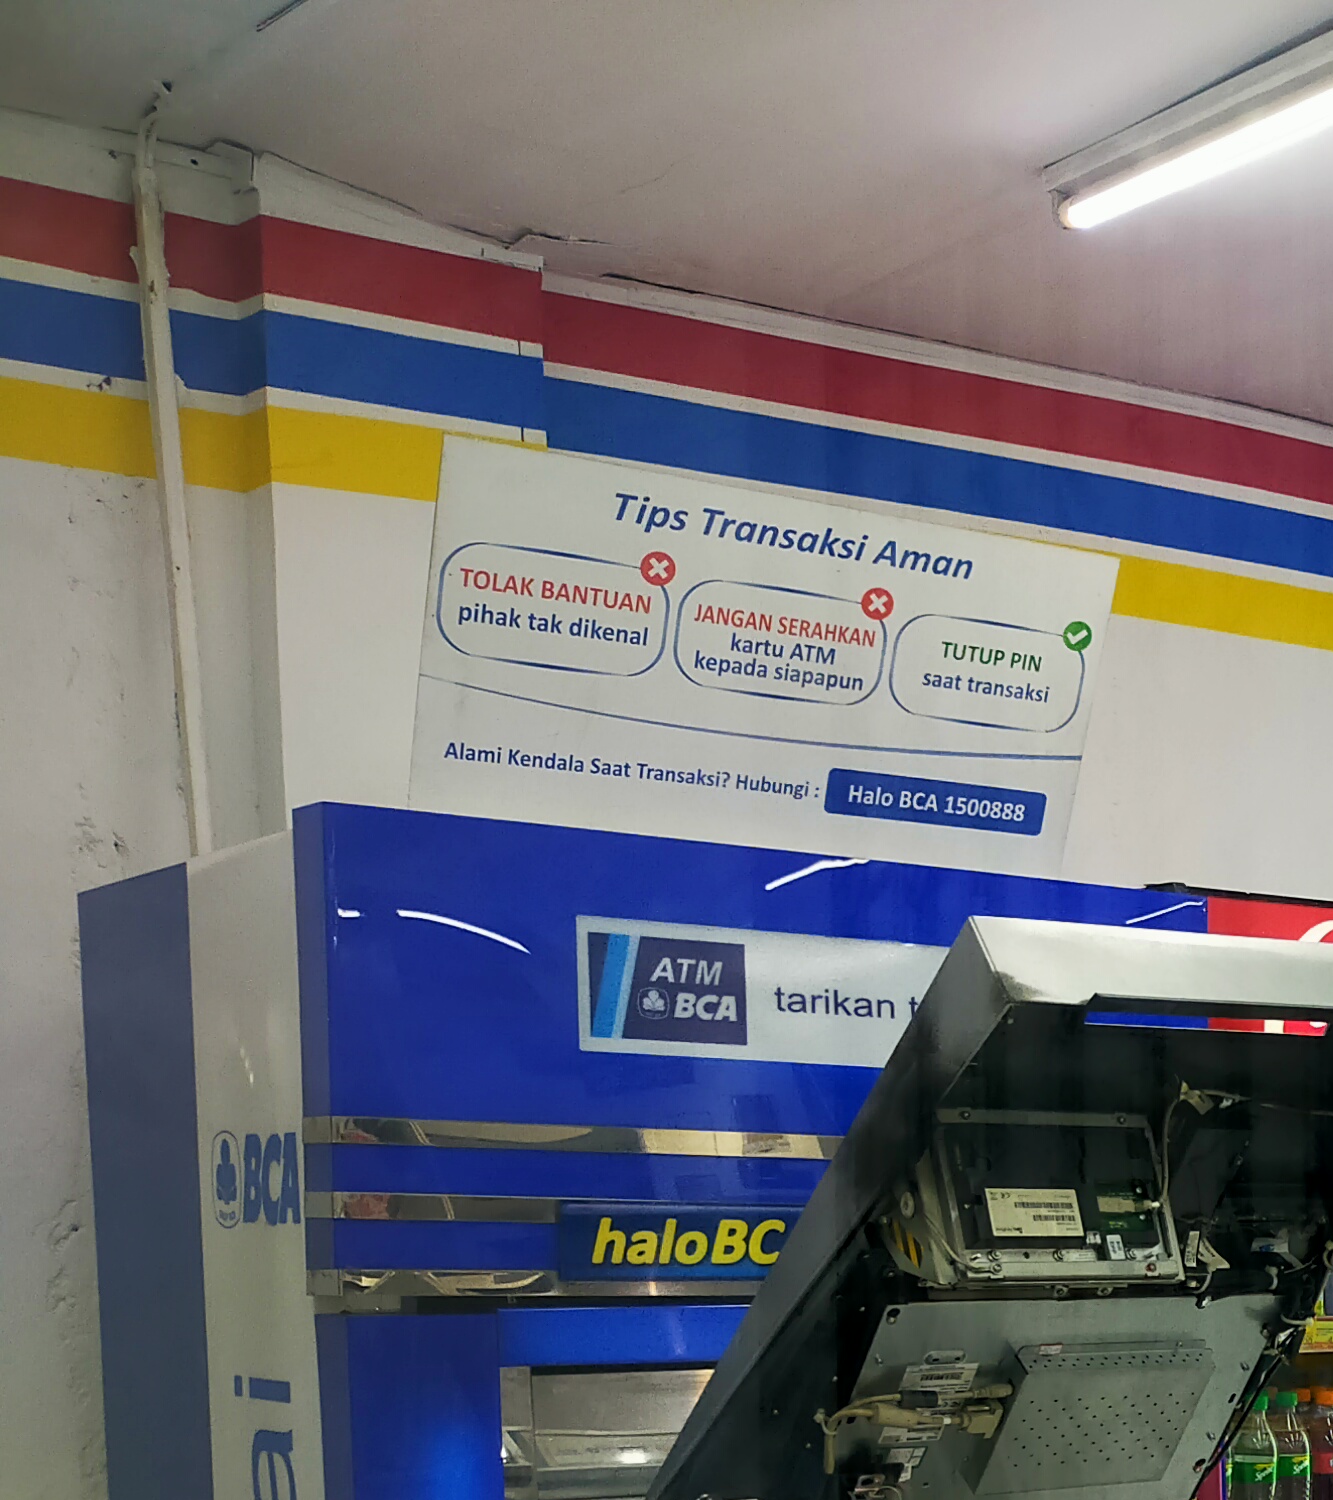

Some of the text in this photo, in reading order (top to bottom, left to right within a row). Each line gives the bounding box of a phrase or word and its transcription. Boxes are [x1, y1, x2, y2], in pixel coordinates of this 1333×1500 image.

[613, 491, 974, 581] Tips Transaksi Aman
[460, 568, 652, 614] TOLAK BANTUAN
[457, 602, 649, 647] pihak tak dikenal
[693, 603, 876, 647] JANGAN SERAHKAN
[730, 633, 836, 665] kartu ATM
[941, 640, 1043, 672] TUTUP PIN
[694, 650, 864, 693] kepada siapapun
[922, 671, 1050, 703] saat transaksi
[445, 741, 809, 798] Alami Kendala Saat Transaksi? Hubungi
[848, 784, 1025, 822] Halo BCA 1500888
[650, 956, 722, 986] ATM
[673, 992, 738, 1023] BCA
[774, 985, 896, 1020] tarikan
[243, 1132, 302, 1226] BCA
